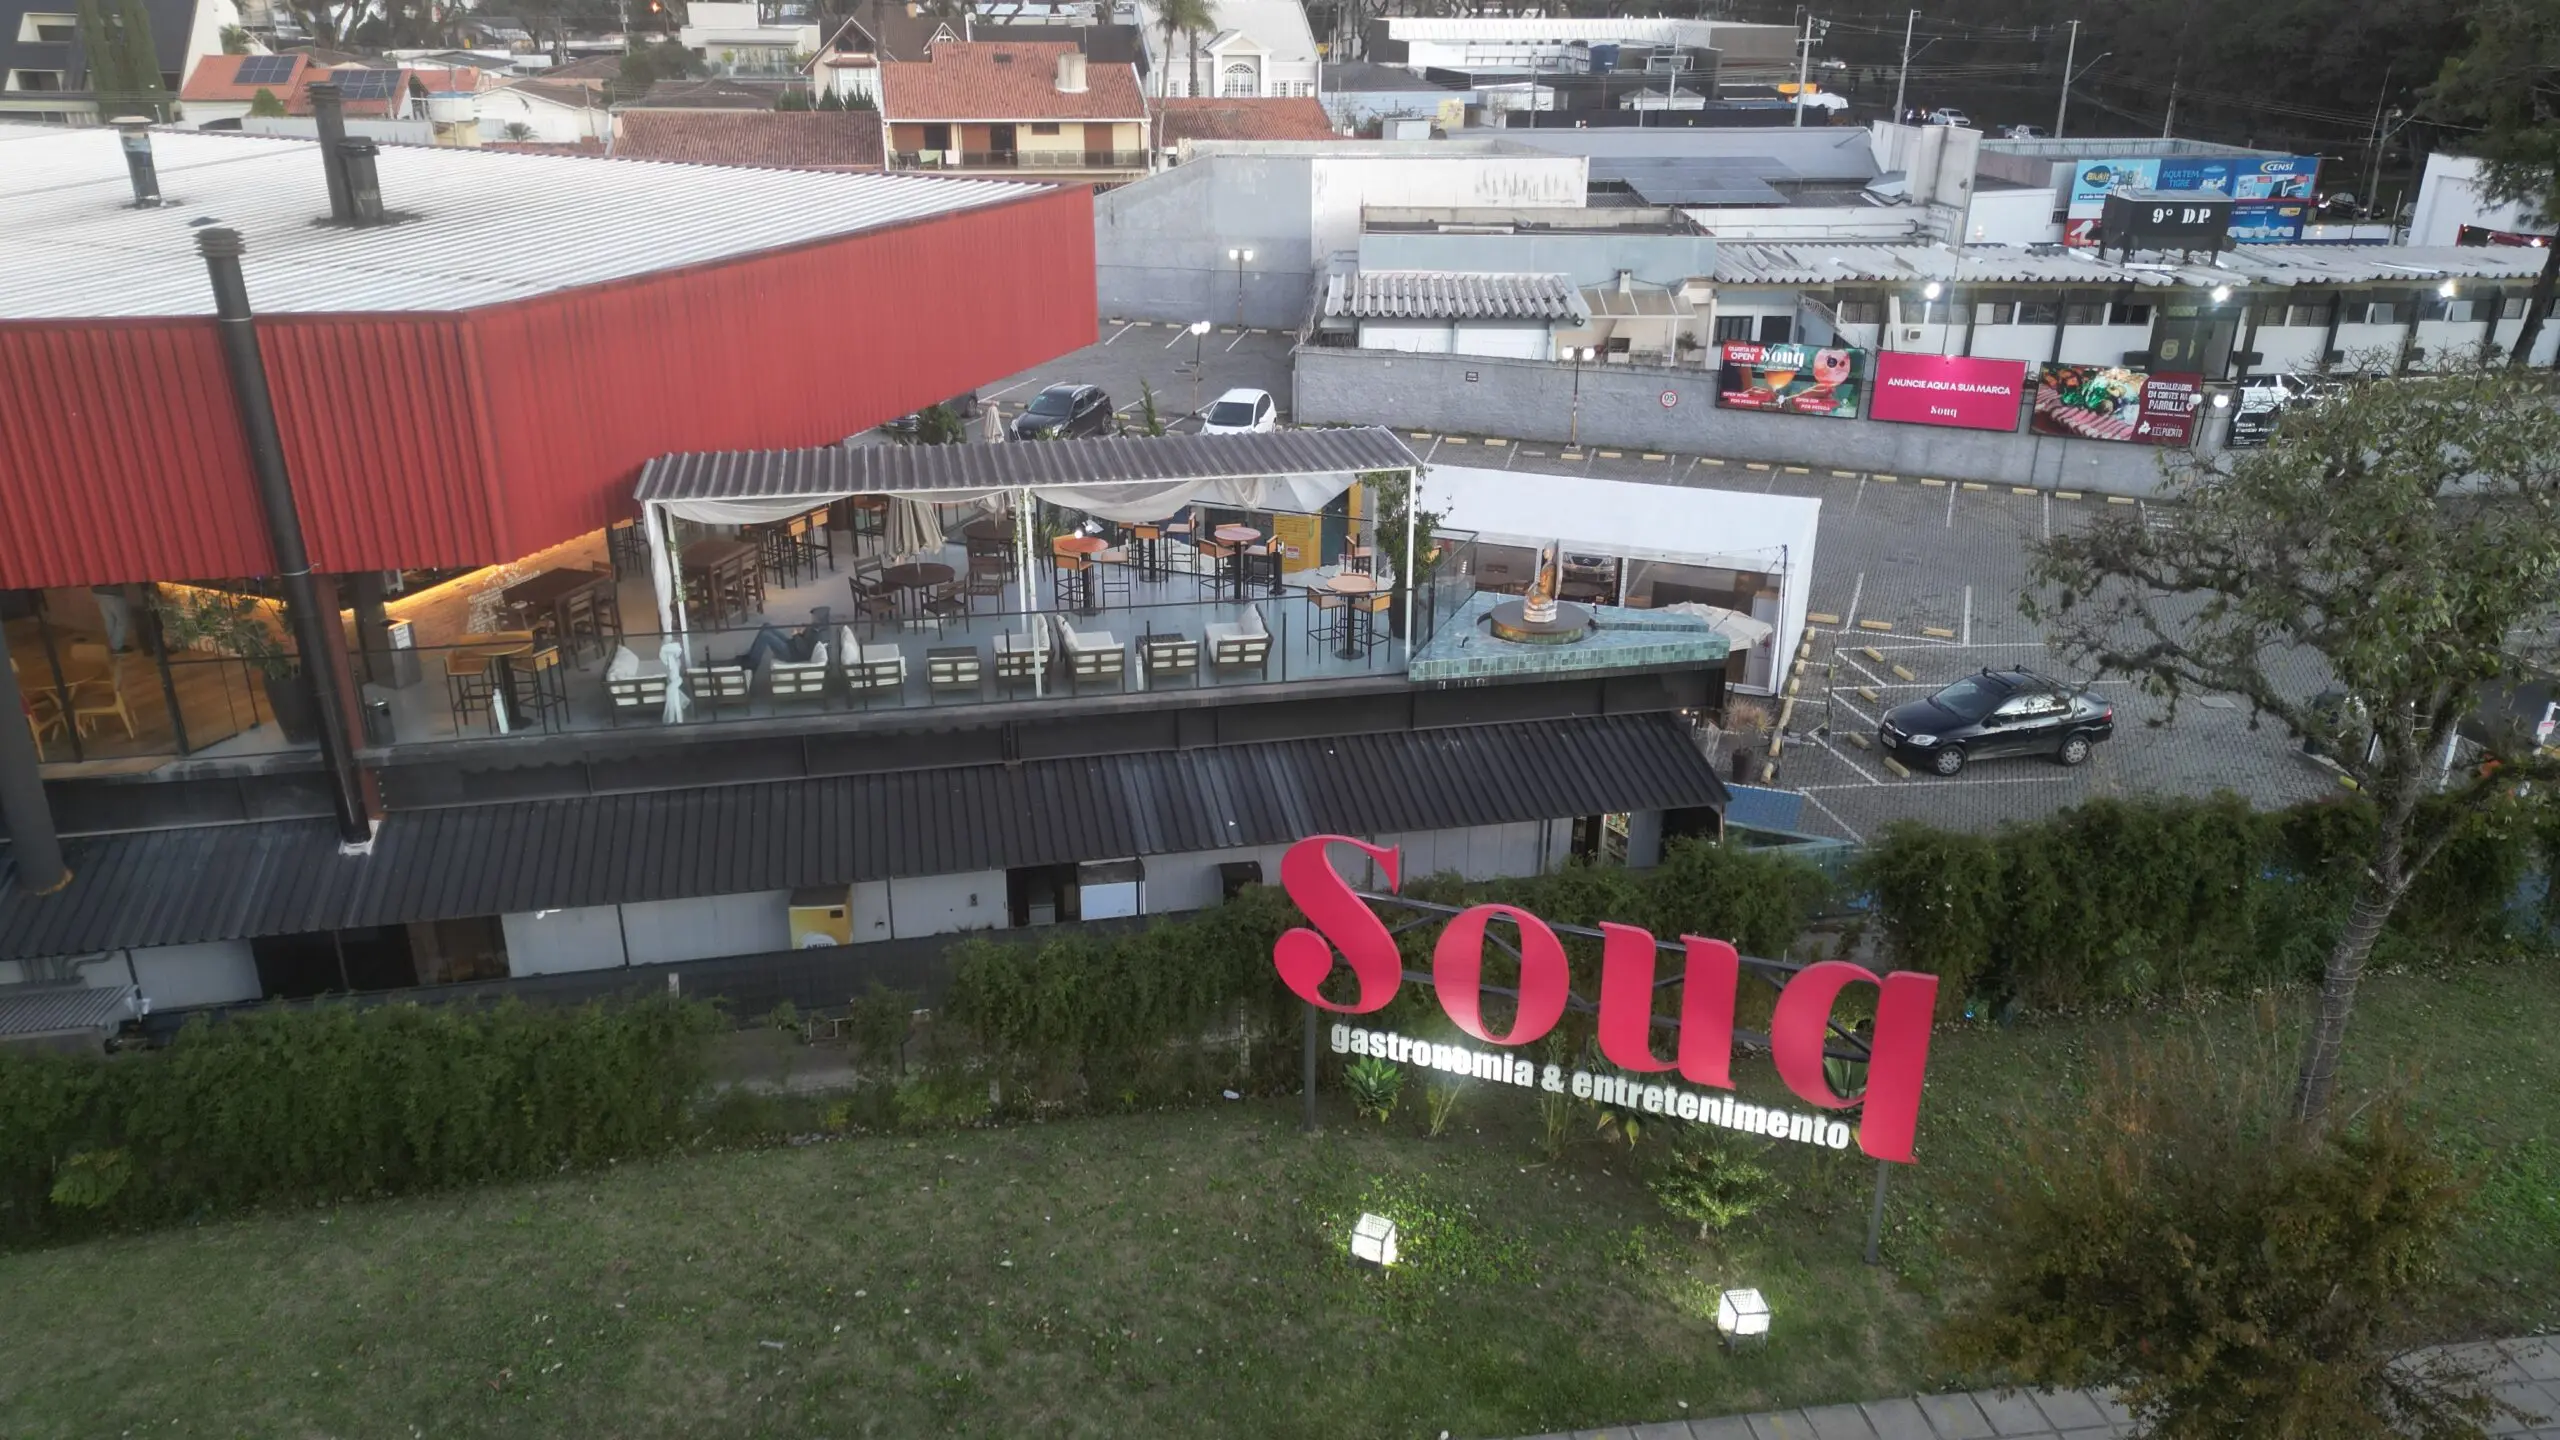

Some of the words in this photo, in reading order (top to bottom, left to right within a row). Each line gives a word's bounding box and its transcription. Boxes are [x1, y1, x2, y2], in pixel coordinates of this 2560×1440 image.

[1731, 352, 1755, 361] OPEN
[1760, 346, 1804, 368] Souq
[1887, 377, 1927, 389] ANUNCIE
[1927, 381, 1950, 391] AQUI
[1950, 382, 1957, 391] A
[1958, 383, 1976, 393] SUA
[1976, 385, 2011, 395] MARCA
[1930, 405, 1958, 418] Souq
[2148, 400, 2185, 412] PARRILLA
[1273, 833, 1939, 1165] Souq
[1331, 1022, 1534, 1088] gastronomia
[1541, 1064, 1564, 1092] &
[1572, 1071, 1851, 1150] entretenimento
